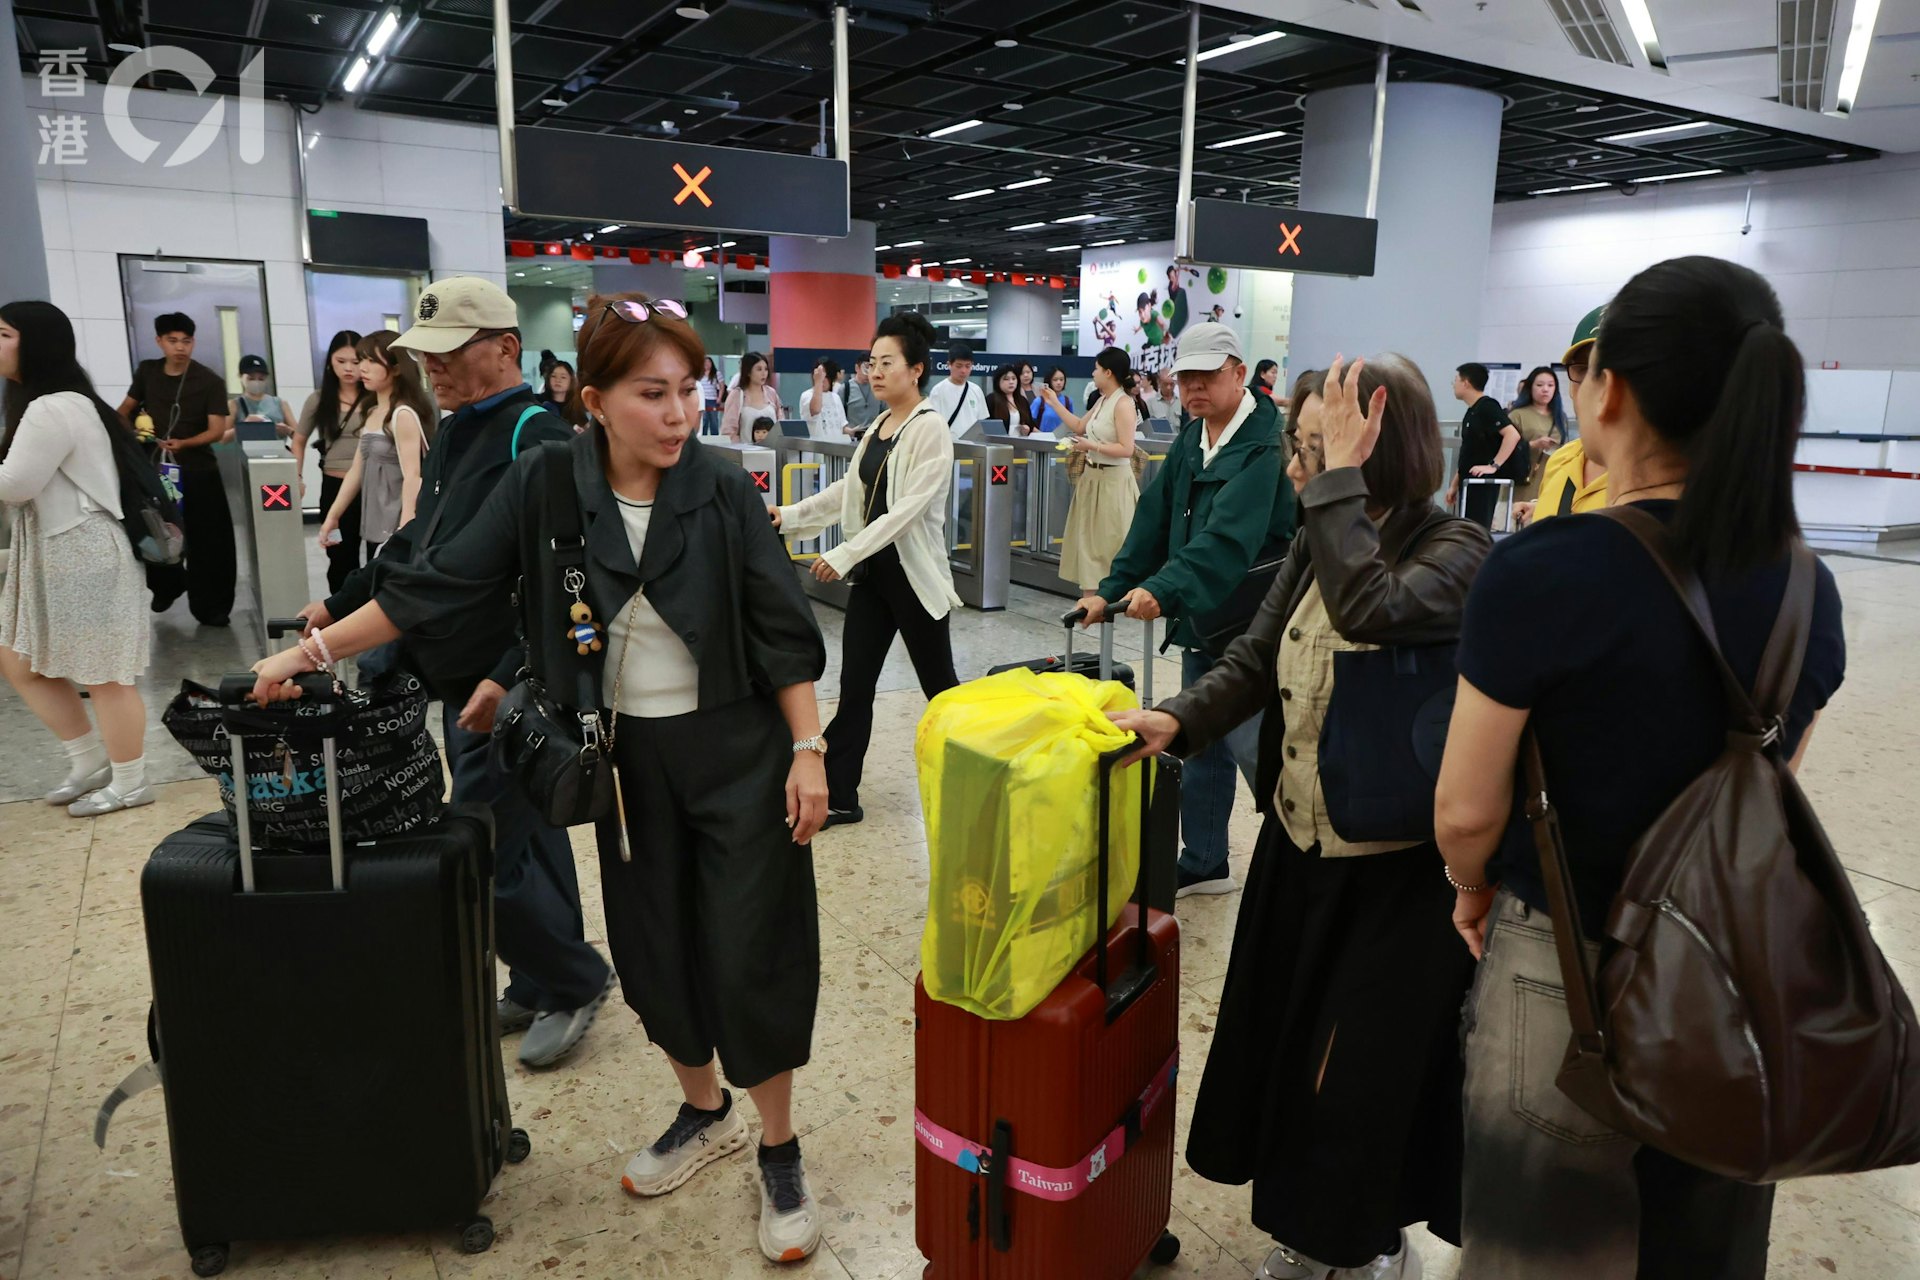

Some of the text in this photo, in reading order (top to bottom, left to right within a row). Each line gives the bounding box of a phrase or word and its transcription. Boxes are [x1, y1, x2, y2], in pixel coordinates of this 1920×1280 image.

[400, 775, 430, 801] Alaska
[914, 1121, 945, 1149] aiwan
[1017, 1168, 1074, 1192] Taiwan
